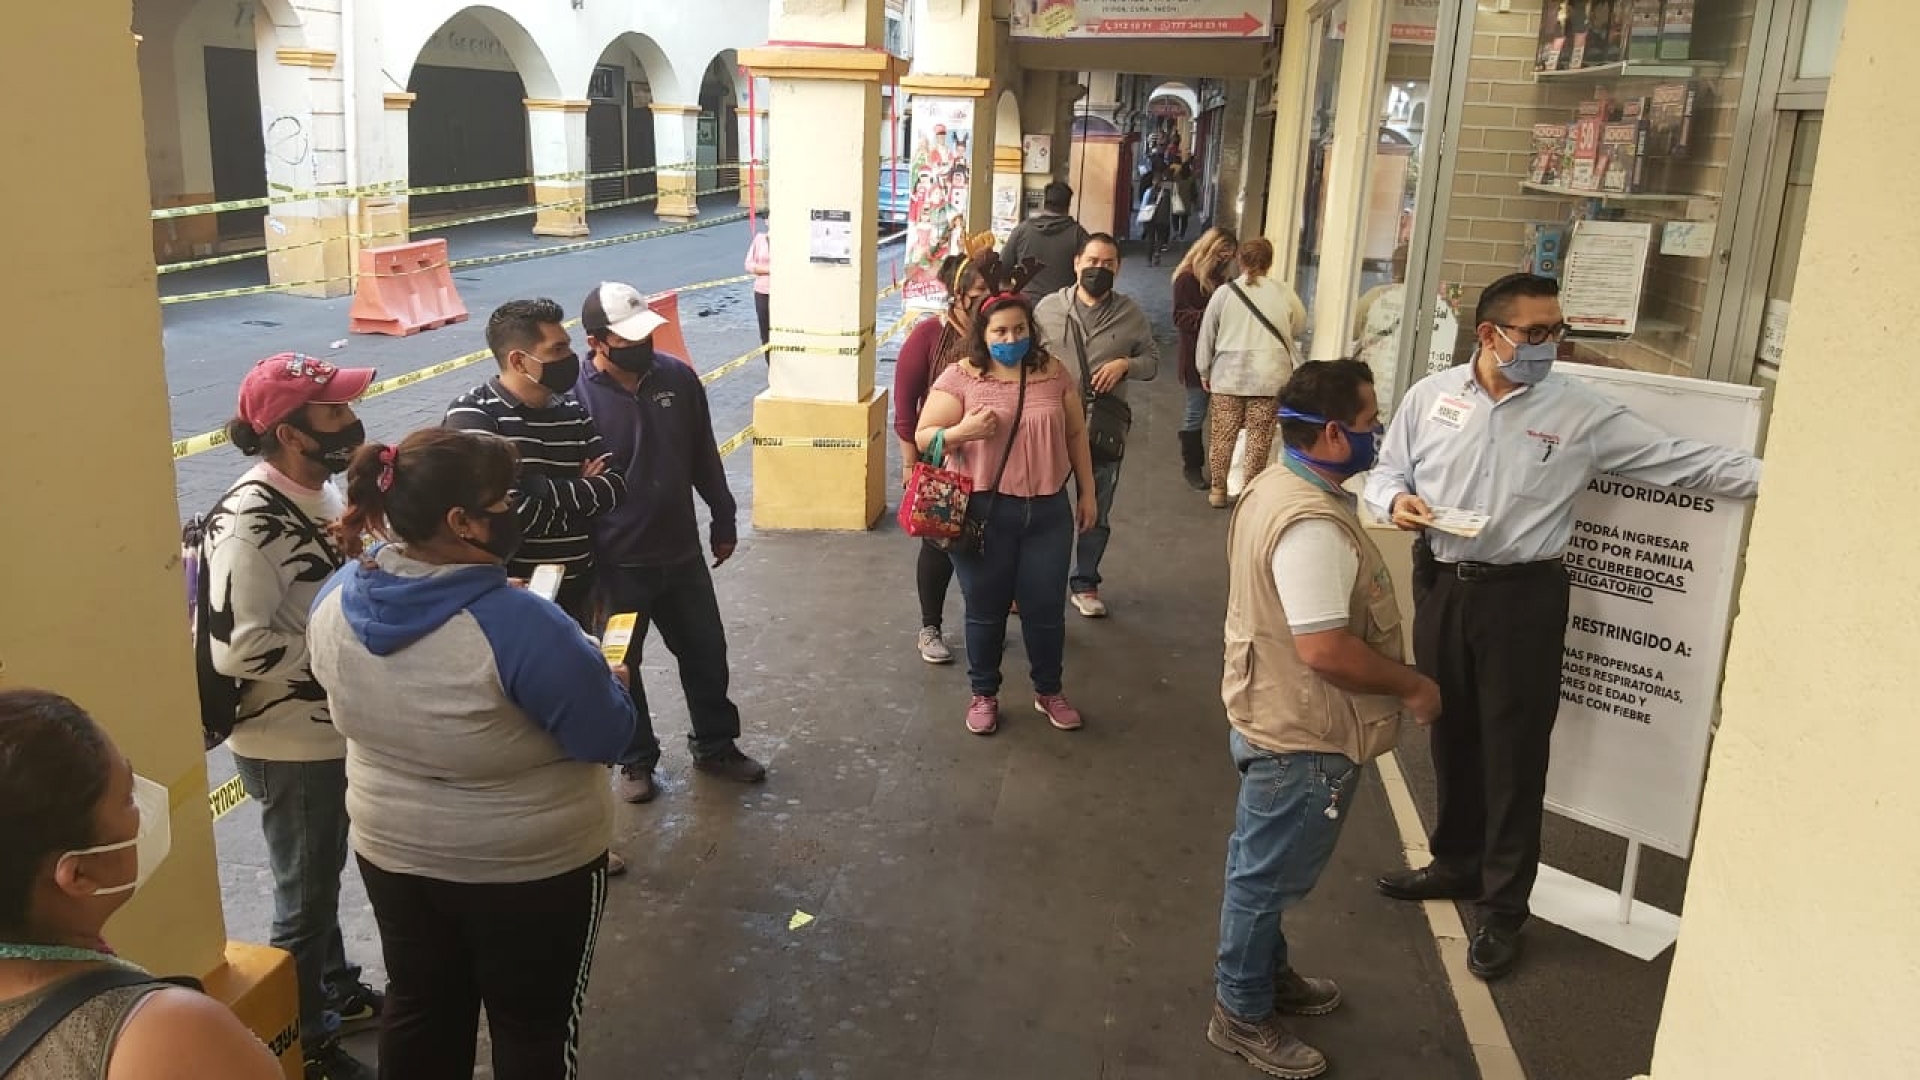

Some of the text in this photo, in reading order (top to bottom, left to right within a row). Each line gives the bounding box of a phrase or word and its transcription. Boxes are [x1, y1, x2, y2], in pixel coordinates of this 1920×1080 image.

[1587, 478, 1715, 513] AUTORIDADES
[1574, 520, 1690, 552] PODRÁ INGRESAR
[1567, 552, 1685, 588] DE CUBREBOCAS
[1601, 542, 1631, 559] POR
[1635, 550, 1694, 572] FAMILIA
[1572, 615, 1692, 657] RESTRINGIDO A:
[1586, 652, 1653, 679] PROPENSAS
[1655, 670, 1663, 681] A
[1588, 682, 1603, 696] DE
[1605, 687, 1636, 704] EDAD
[1638, 696, 1648, 707] Y
[1593, 669, 1683, 703] RESPIRATORIAS,
[1561, 689, 1651, 724] NAS CON FIEBRE
